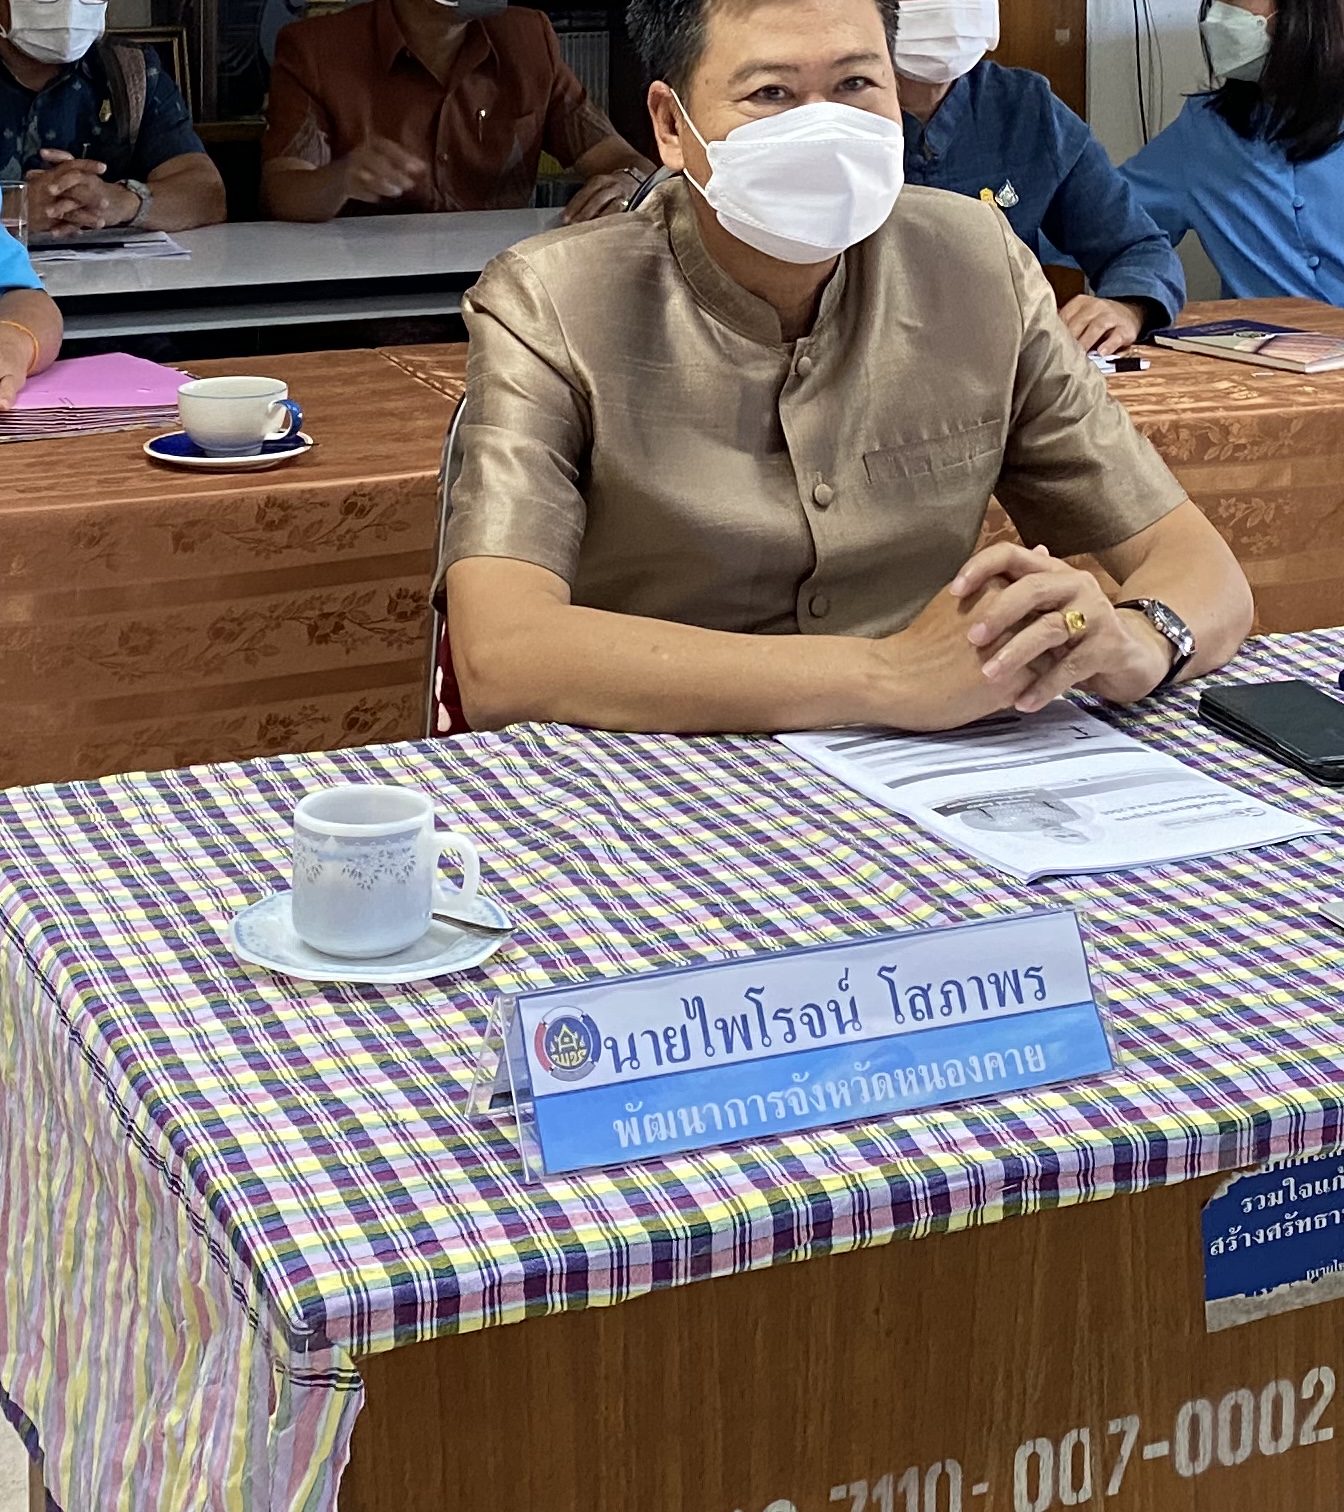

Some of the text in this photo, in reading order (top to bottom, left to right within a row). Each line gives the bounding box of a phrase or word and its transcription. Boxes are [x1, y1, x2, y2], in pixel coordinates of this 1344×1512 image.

[603, 962, 1048, 1075] นายไพโรจน์ โสภาพร
[612, 1039, 1048, 1149] พัฒนาการจังหวัดหนองคาย
